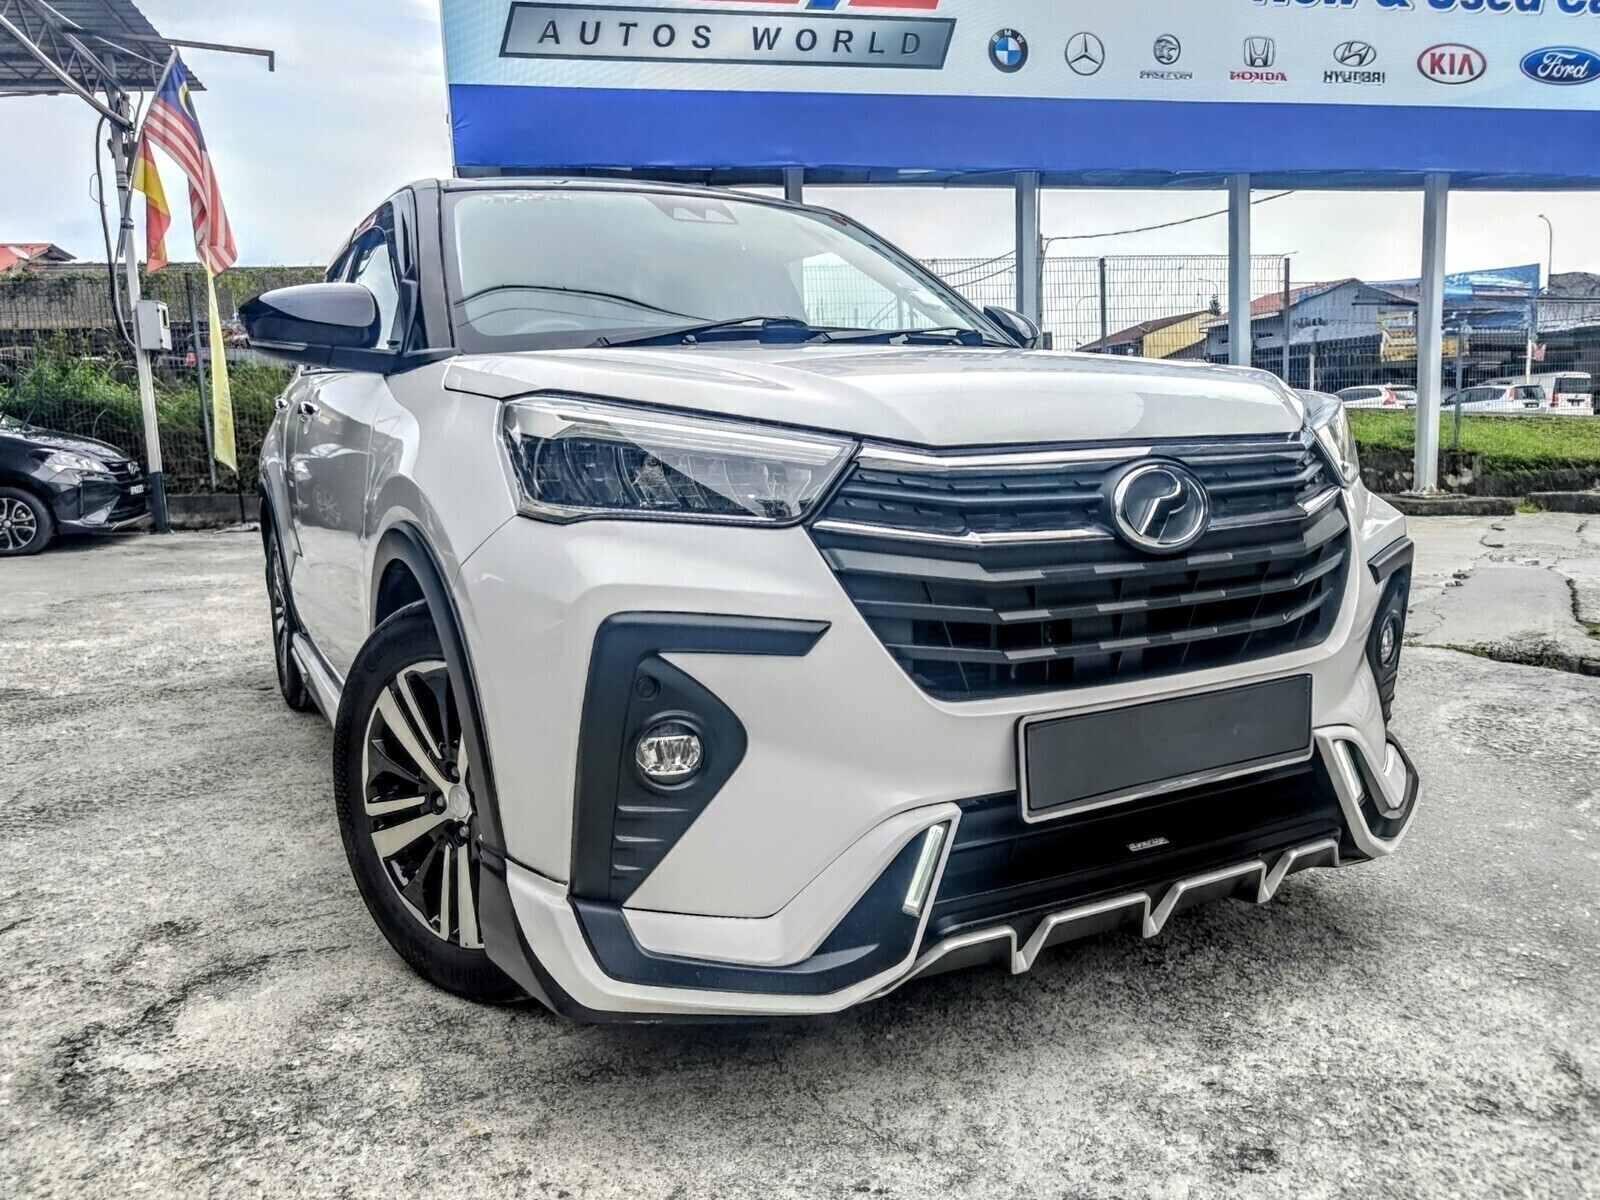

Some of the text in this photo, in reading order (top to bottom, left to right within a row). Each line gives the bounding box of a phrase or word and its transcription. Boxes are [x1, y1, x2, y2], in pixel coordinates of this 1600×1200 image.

[537, 19, 923, 55] AUTOS WORLD
[1229, 71, 1287, 82] HONDA
[1429, 53, 1475, 76] KIA
[1536, 52, 1591, 78] Ford
